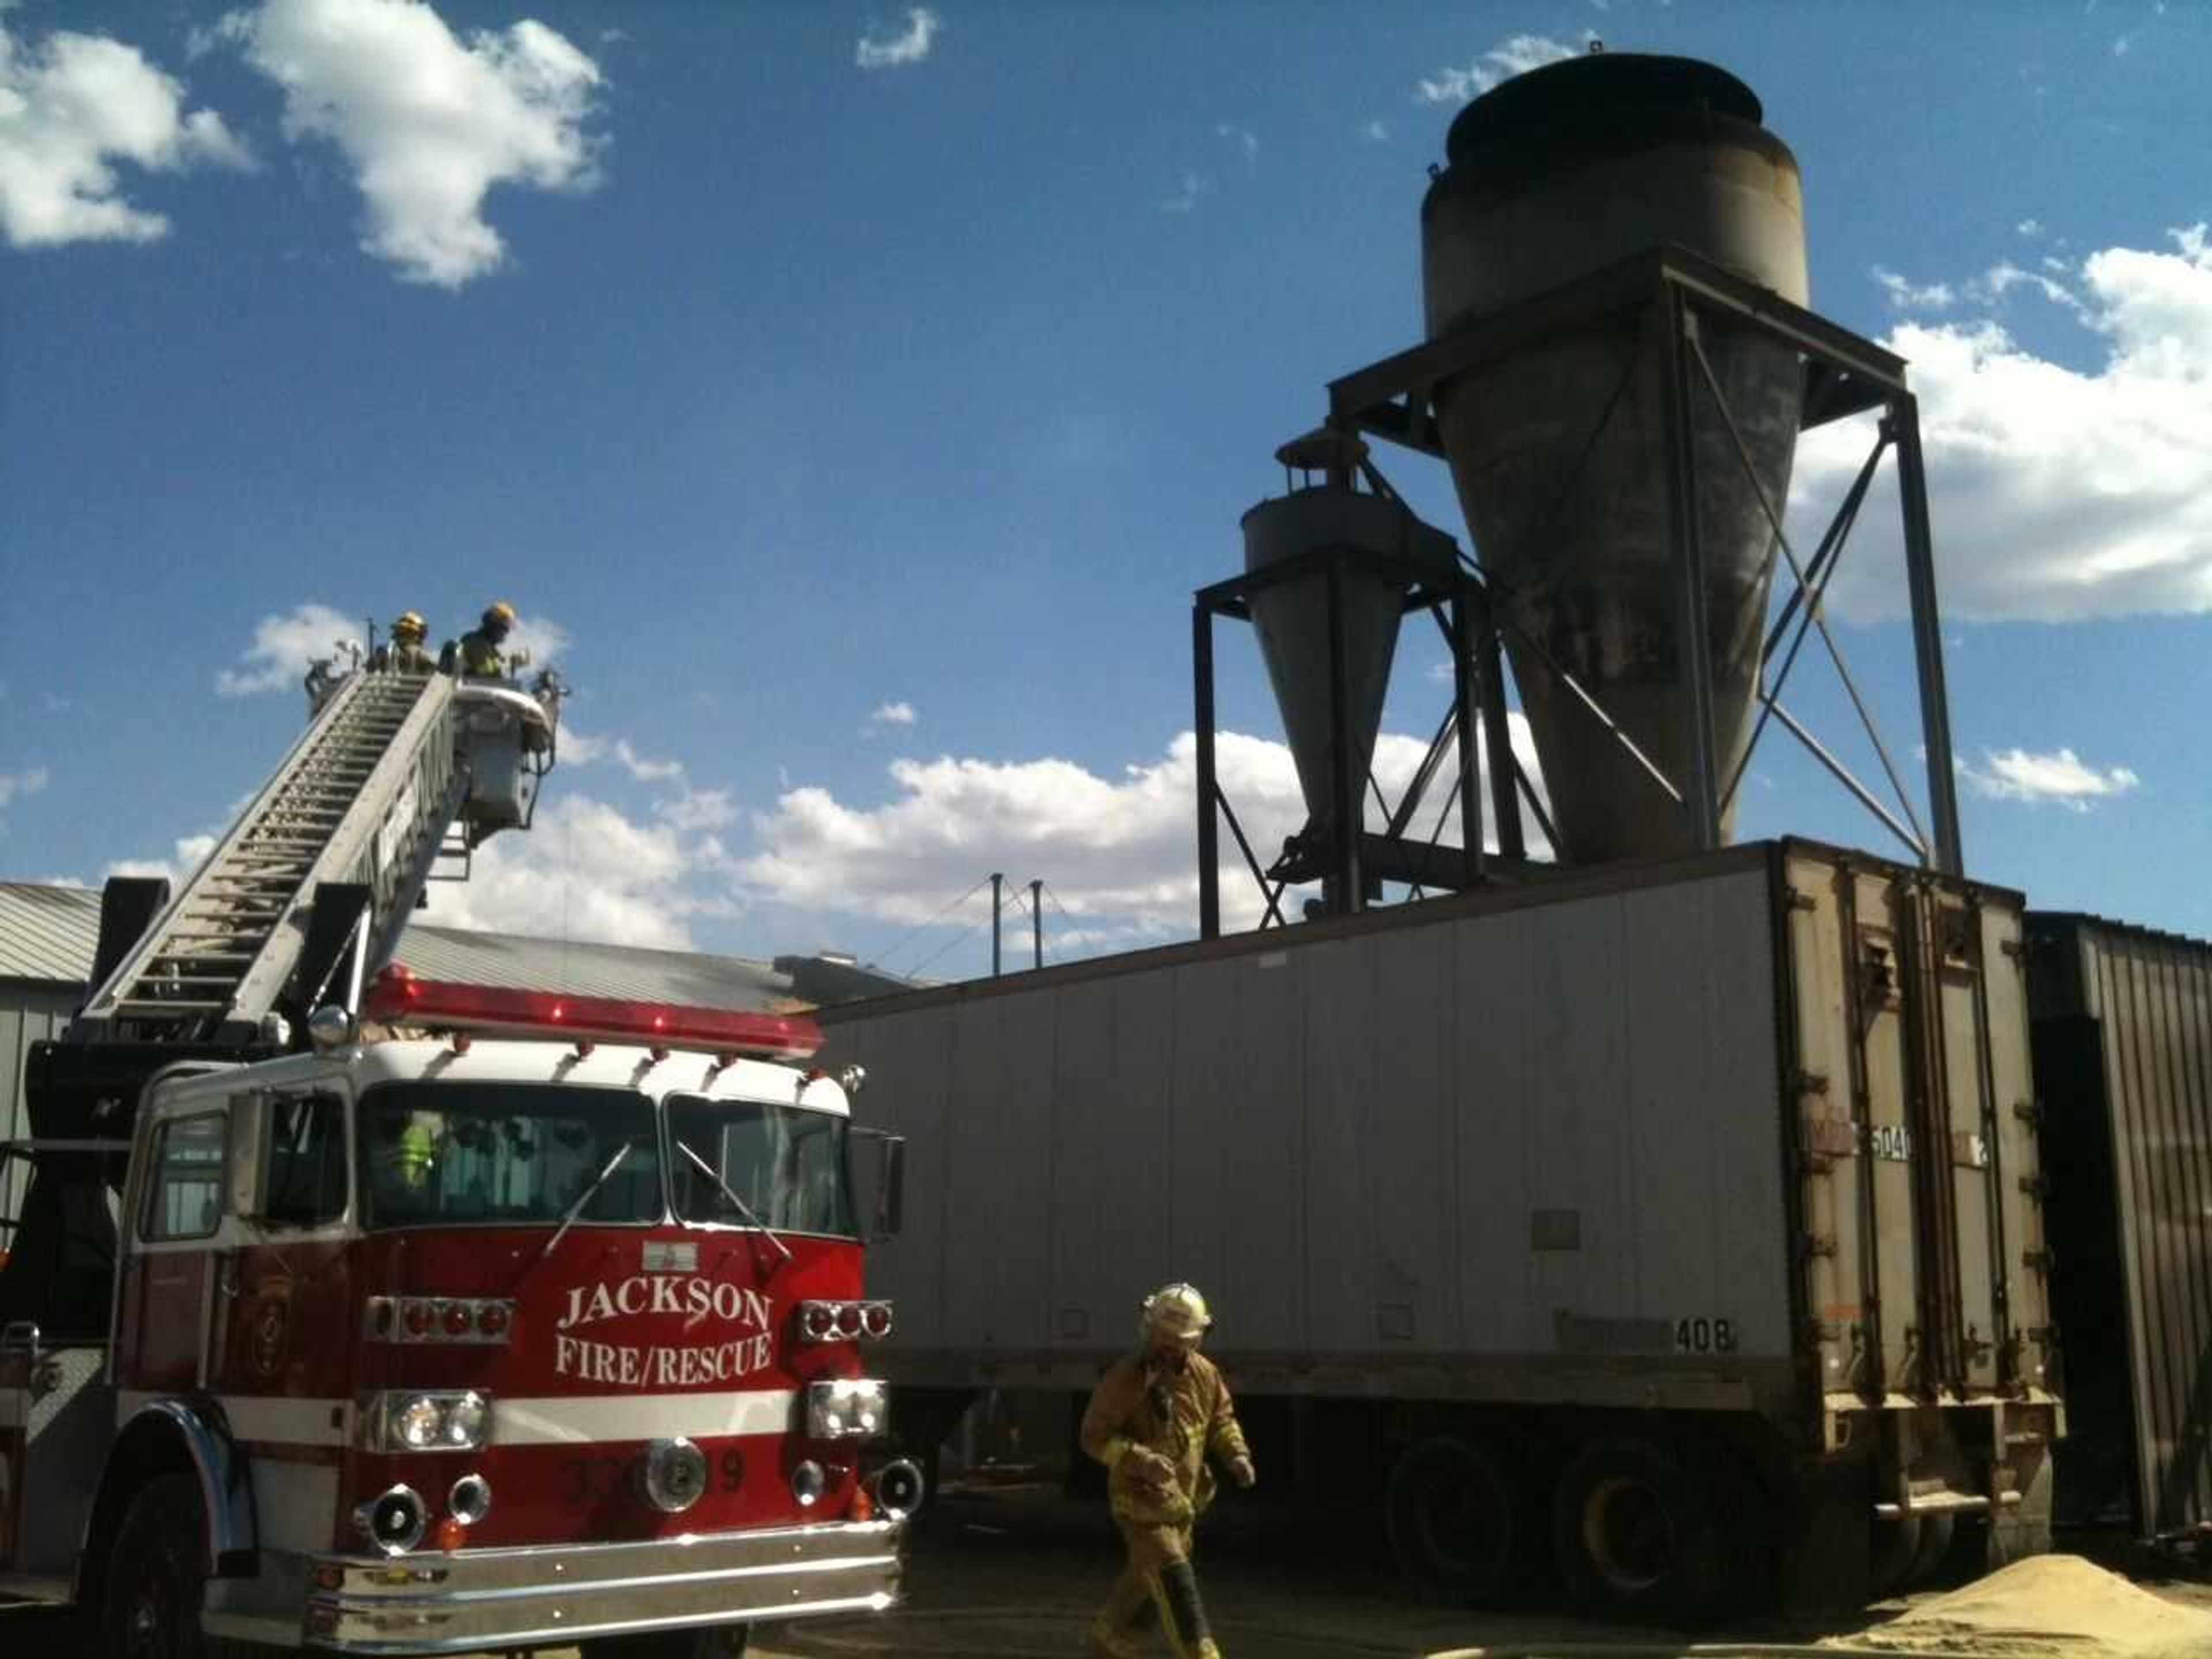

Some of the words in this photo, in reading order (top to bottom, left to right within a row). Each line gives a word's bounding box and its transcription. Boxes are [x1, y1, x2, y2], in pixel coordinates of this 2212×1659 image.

[557, 1275, 773, 1331] JACKSON
[555, 1332, 772, 1387] FIRE/RESCUE
[1677, 1318, 1730, 1352] 408
